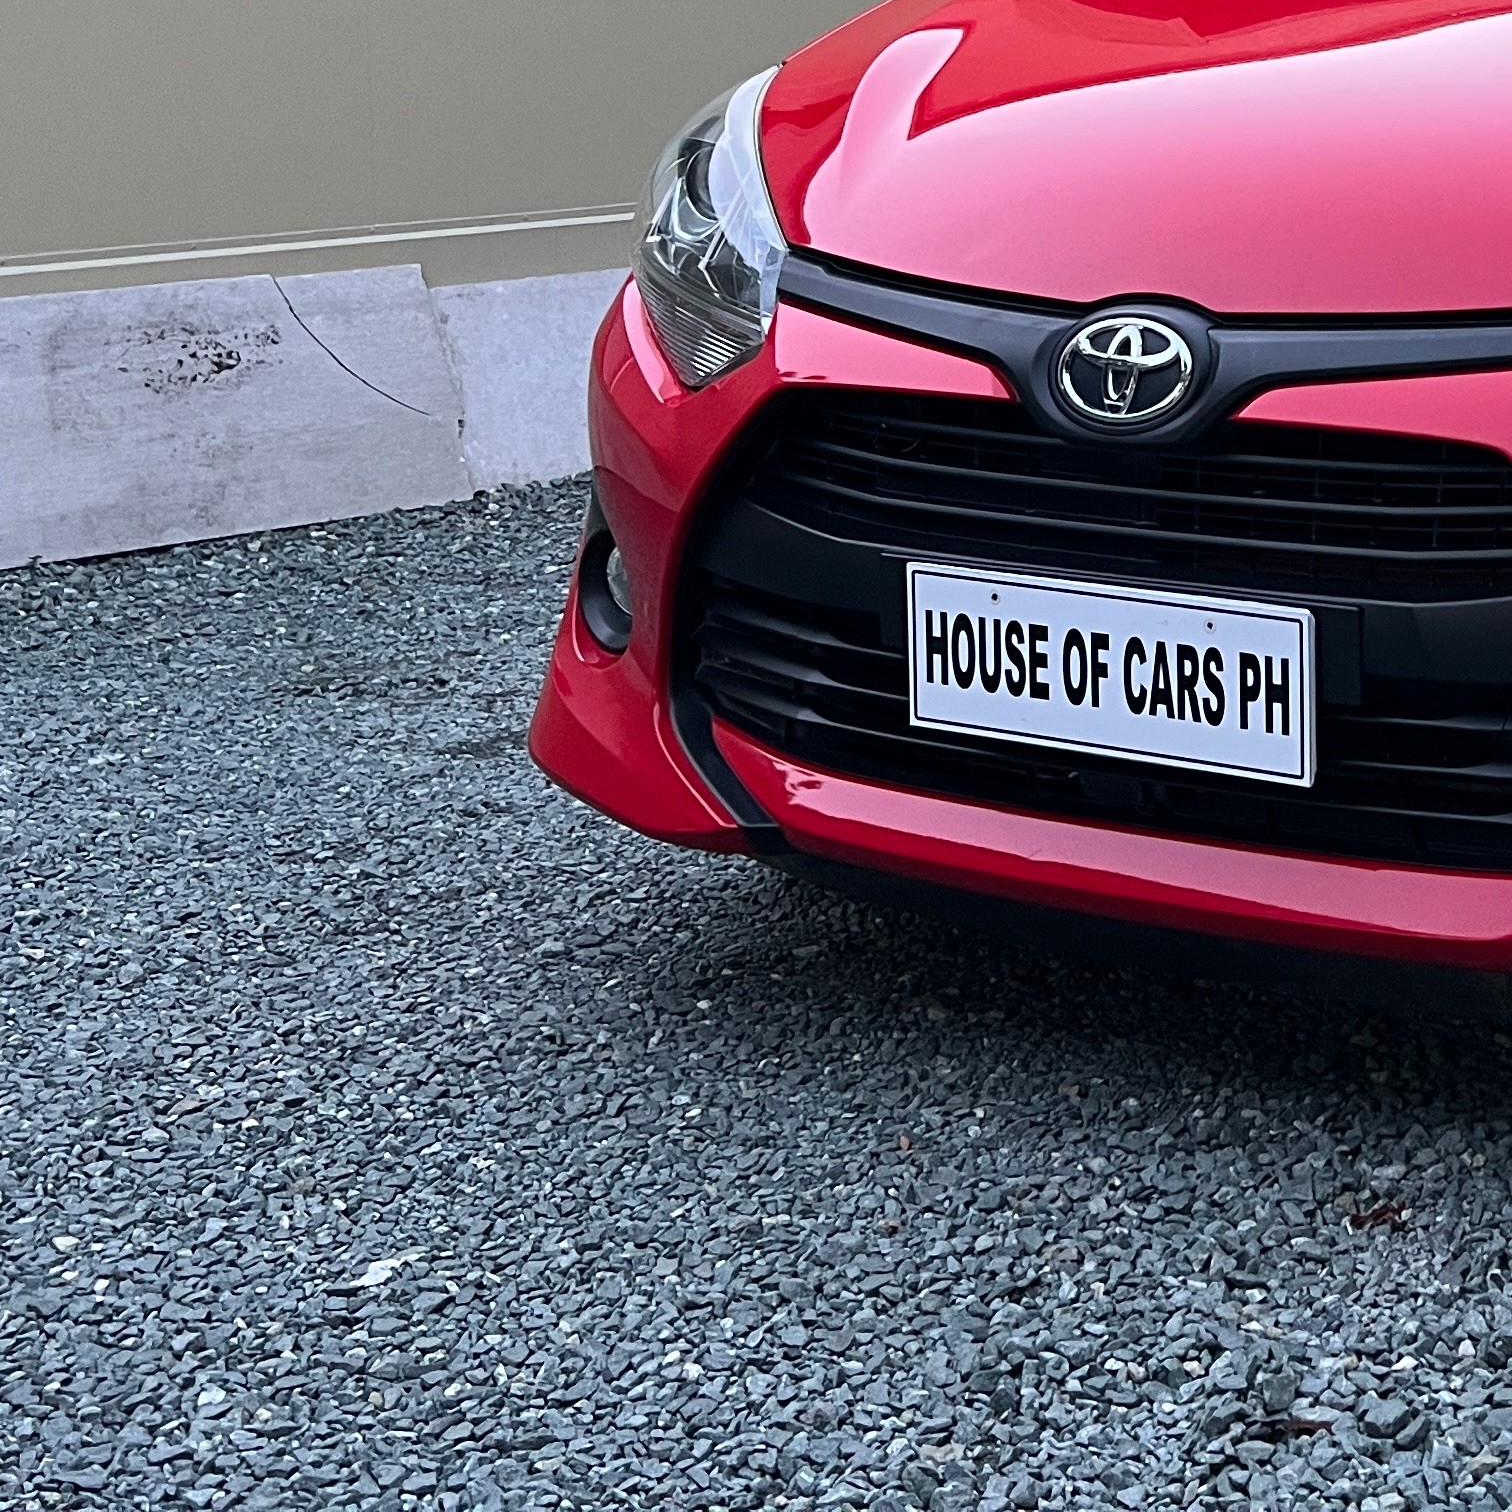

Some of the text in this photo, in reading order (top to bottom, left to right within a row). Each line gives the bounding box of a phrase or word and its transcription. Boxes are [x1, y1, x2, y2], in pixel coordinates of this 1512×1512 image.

[925, 609, 1290, 737] HOUSE OF CARS PH
